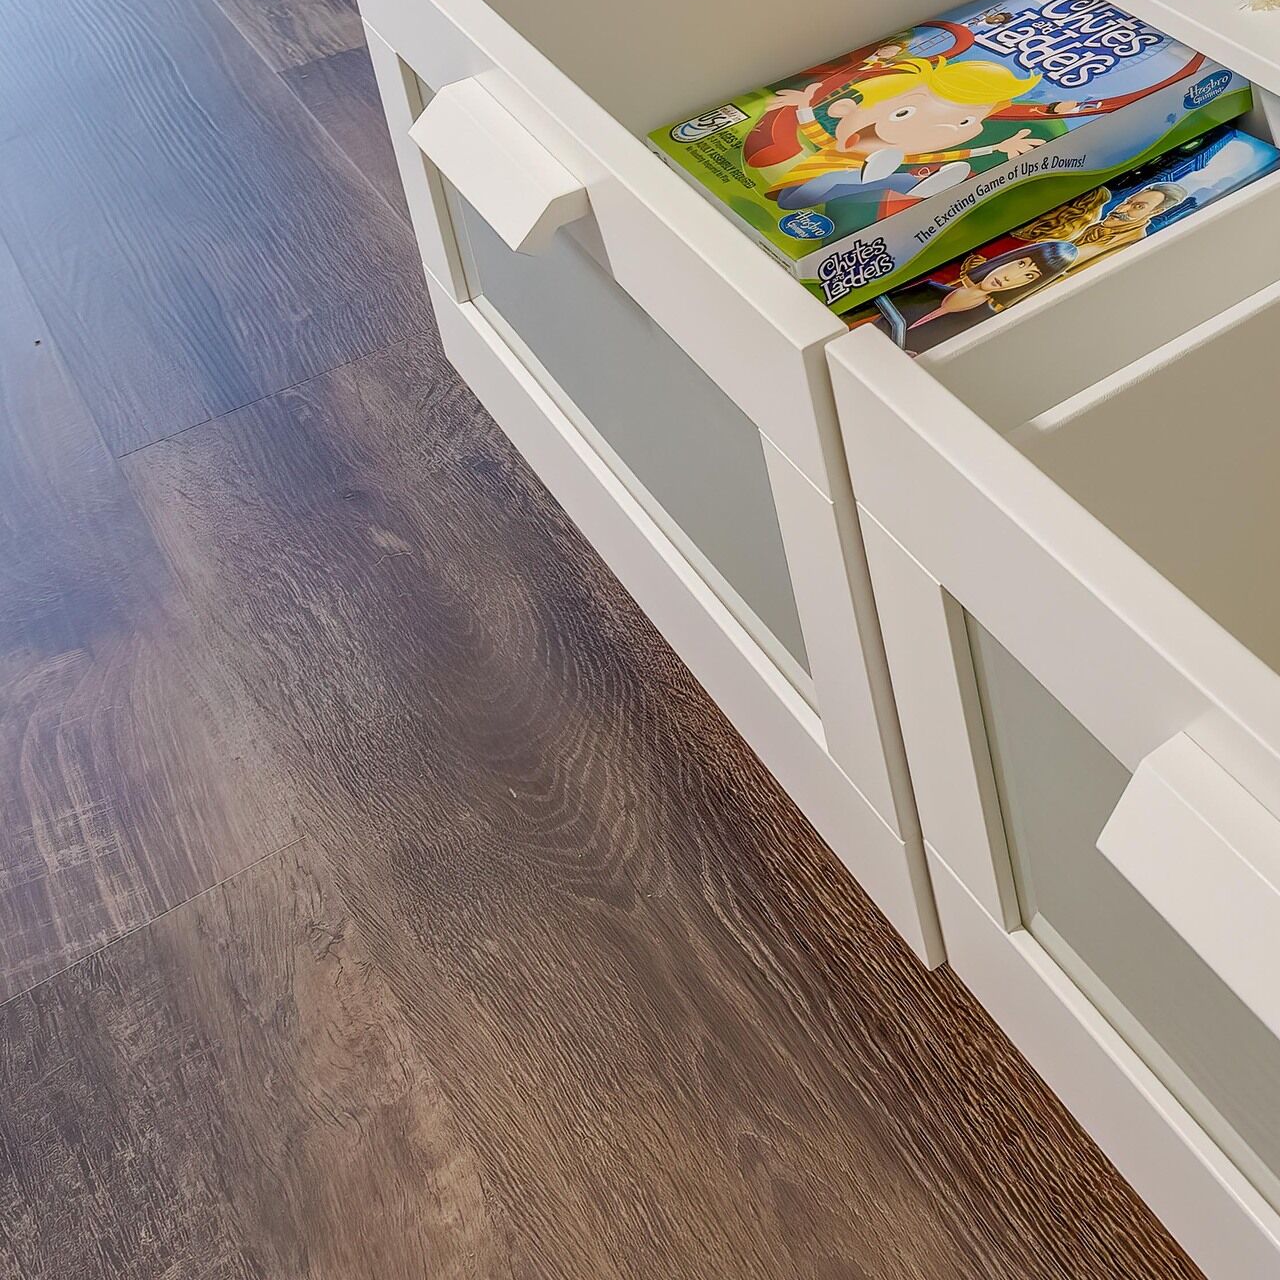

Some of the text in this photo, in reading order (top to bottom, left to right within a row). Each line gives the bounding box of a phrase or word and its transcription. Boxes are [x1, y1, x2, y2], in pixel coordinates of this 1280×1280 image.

[1033, 20, 1058, 35] and
[974, 10, 1115, 88] Ladders
[1185, 75, 1229, 98] Hasbro
[914, 154, 1086, 245] The Exciting Game of Ups & Downs!
[796, 211, 826, 236] Hasbro
[819, 237, 886, 282] Chutes
[821, 253, 895, 305] Ladders
[832, 272, 846, 283] and
